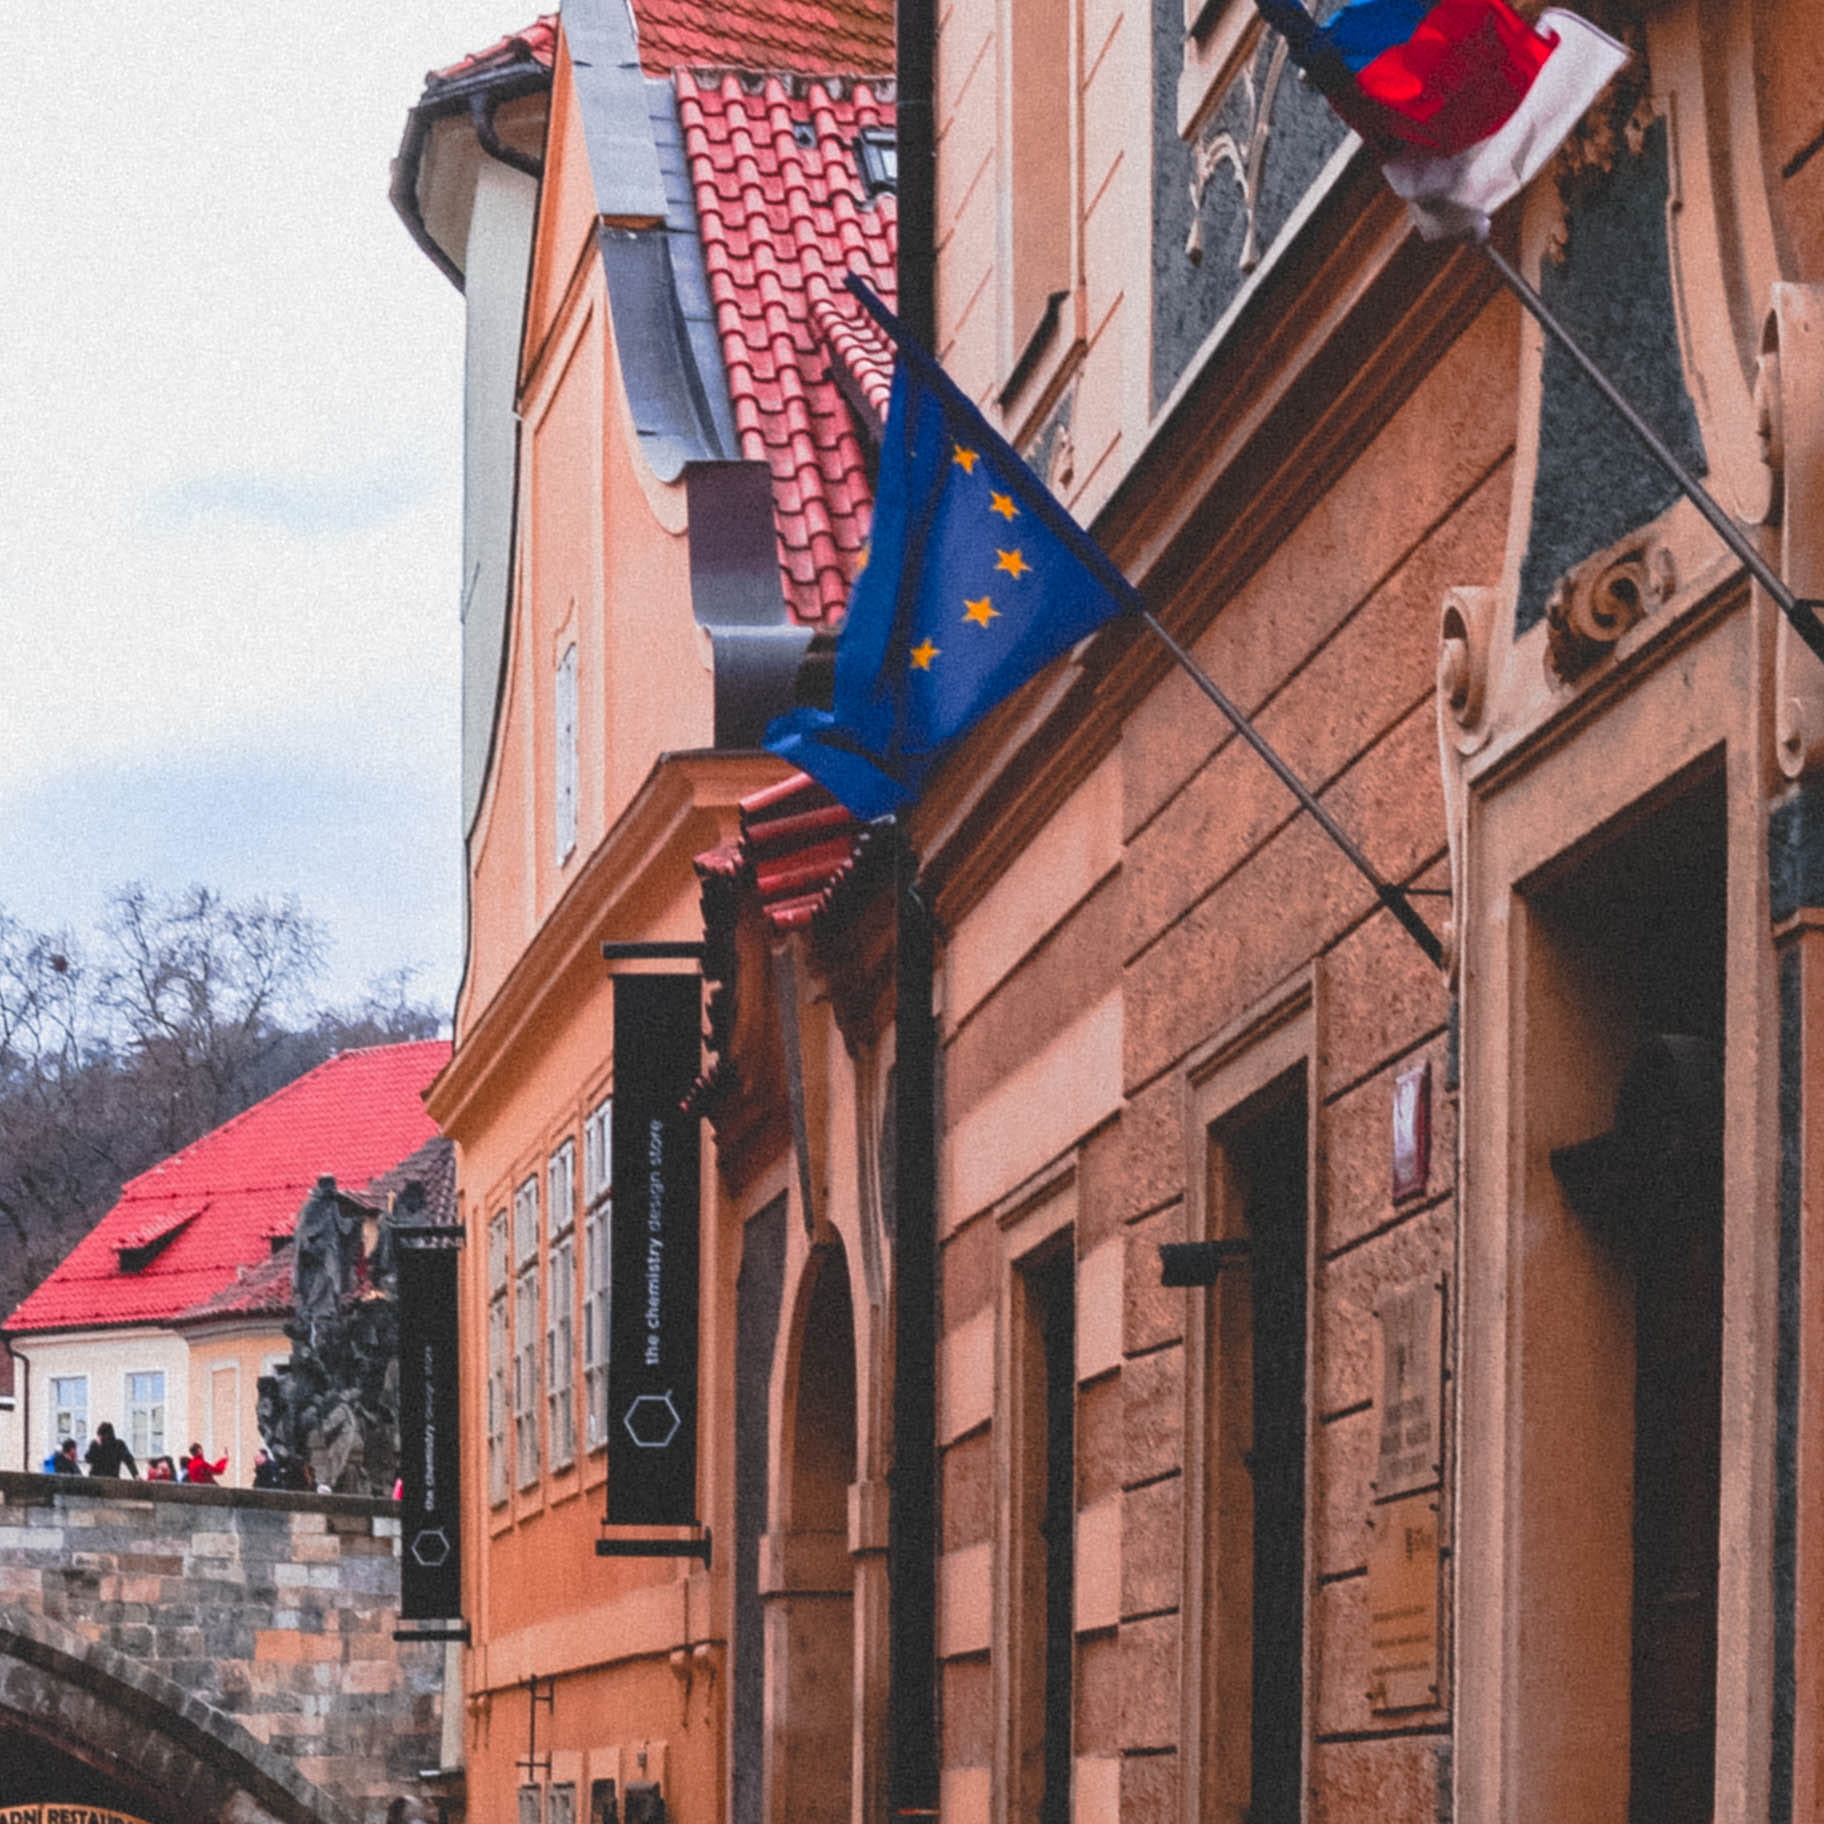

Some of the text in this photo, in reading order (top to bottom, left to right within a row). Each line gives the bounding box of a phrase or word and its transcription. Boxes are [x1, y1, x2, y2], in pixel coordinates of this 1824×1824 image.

[645, 1119, 664, 1365] the chemistry design store
